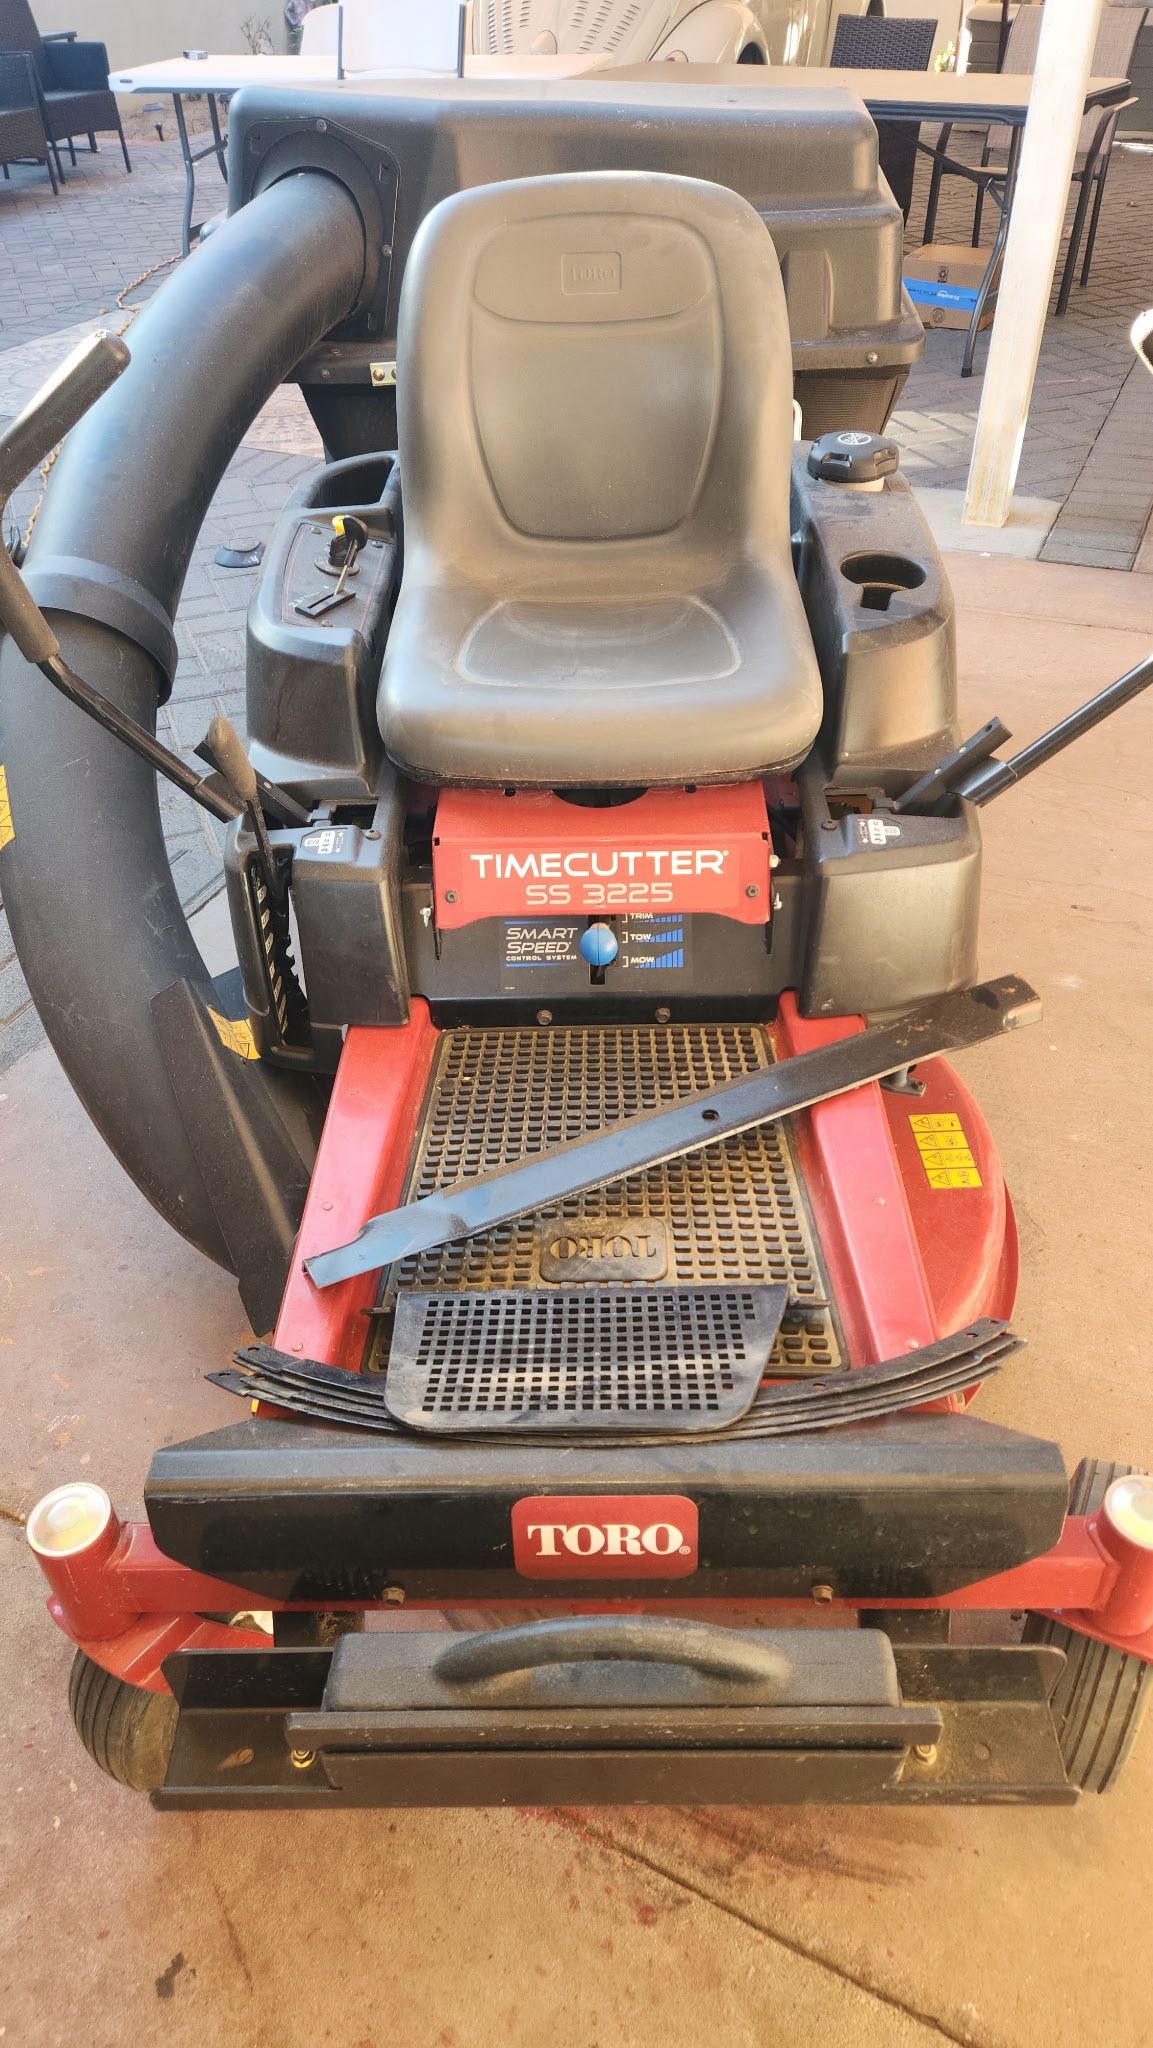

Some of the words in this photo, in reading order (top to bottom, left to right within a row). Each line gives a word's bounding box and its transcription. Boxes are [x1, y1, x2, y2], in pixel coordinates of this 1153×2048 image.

[525, 884, 571, 905] SS
[582, 882, 674, 904] 3225
[506, 927, 578, 940] SMART
[630, 933, 652, 941] TOW
[630, 956, 655, 964] MOW
[549, 1235, 657, 1259] TORO
